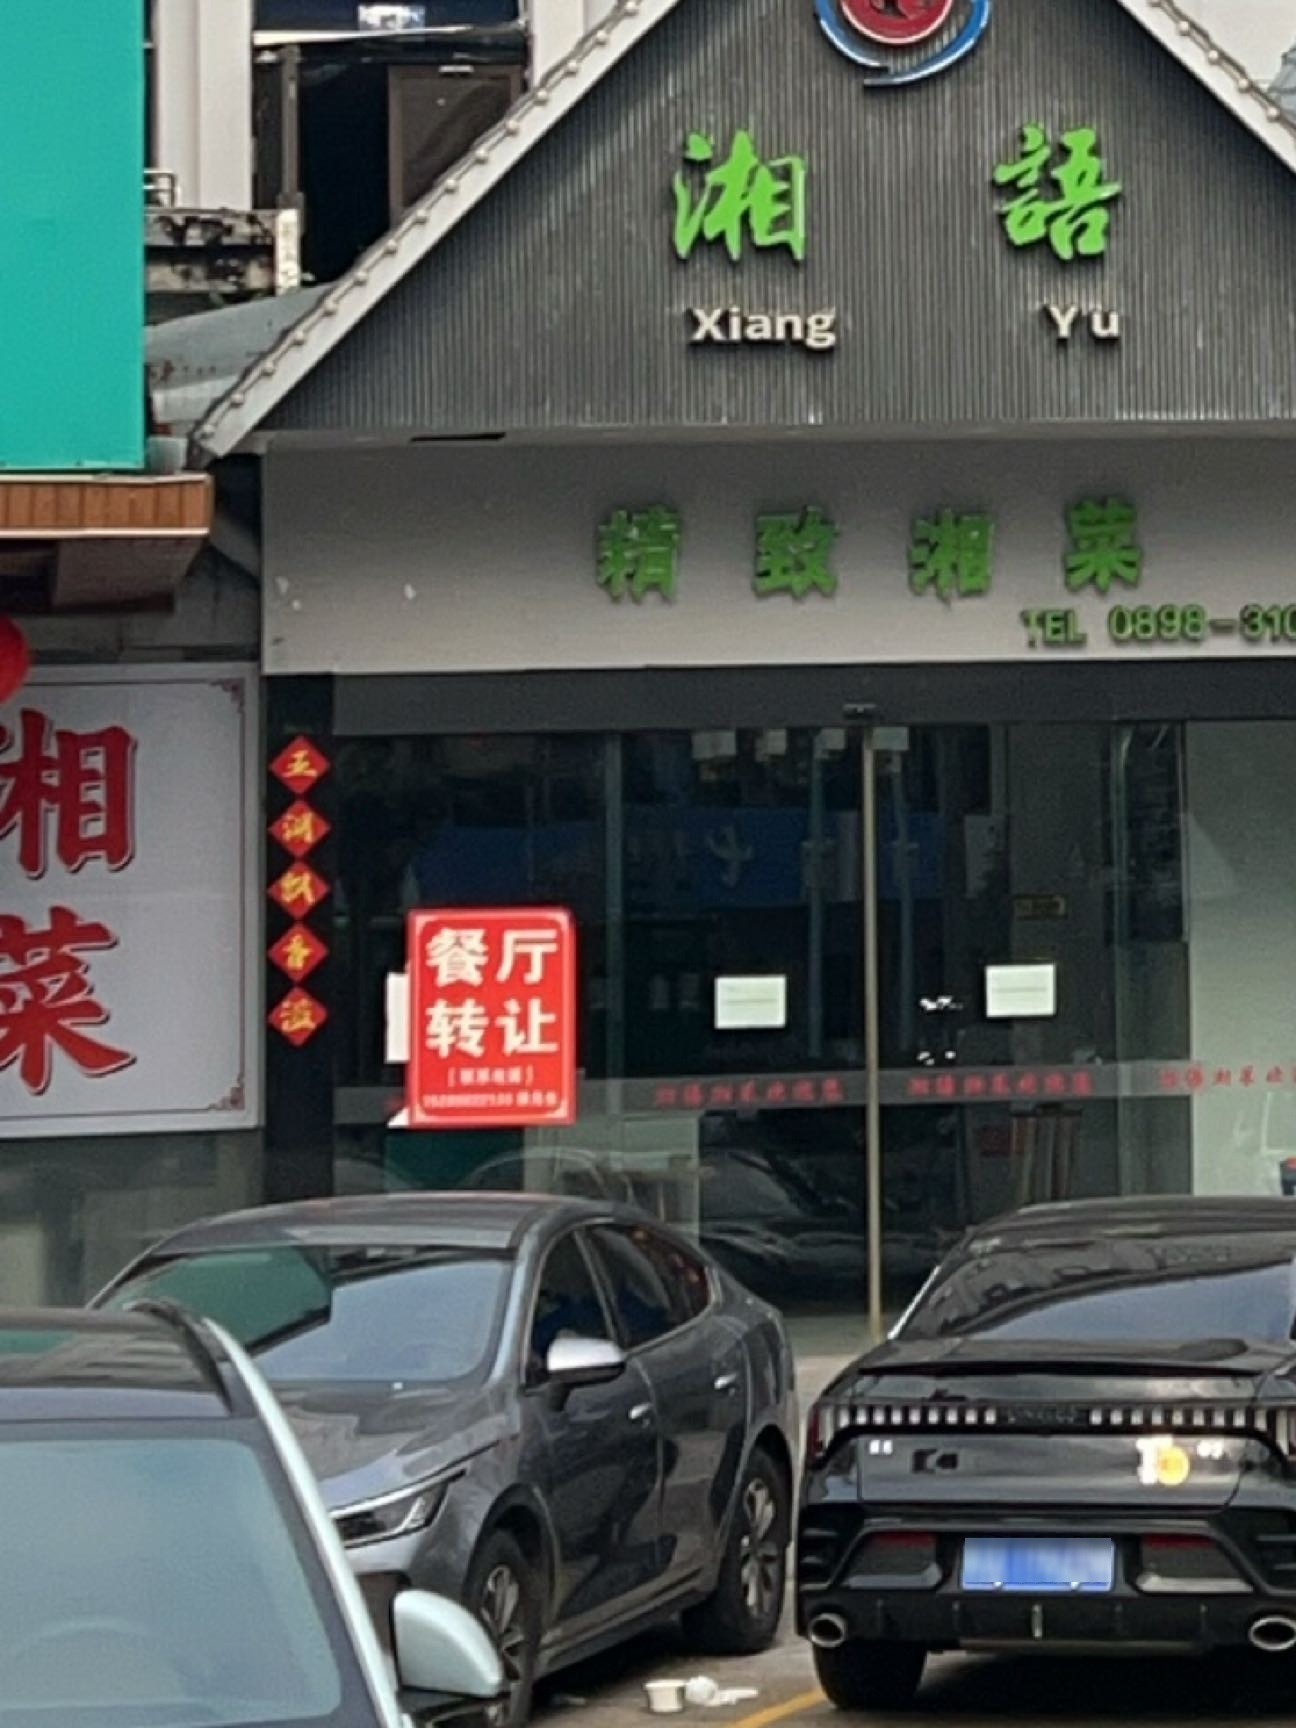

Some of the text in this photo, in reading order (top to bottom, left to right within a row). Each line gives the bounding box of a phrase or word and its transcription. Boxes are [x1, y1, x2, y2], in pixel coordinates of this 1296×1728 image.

[690, 304, 1122, 349] Xiang Yu
[1020, 608, 1087, 647] TEL
[425, 927, 559, 987] 餐厅
[425, 998, 560, 1058] 转让
